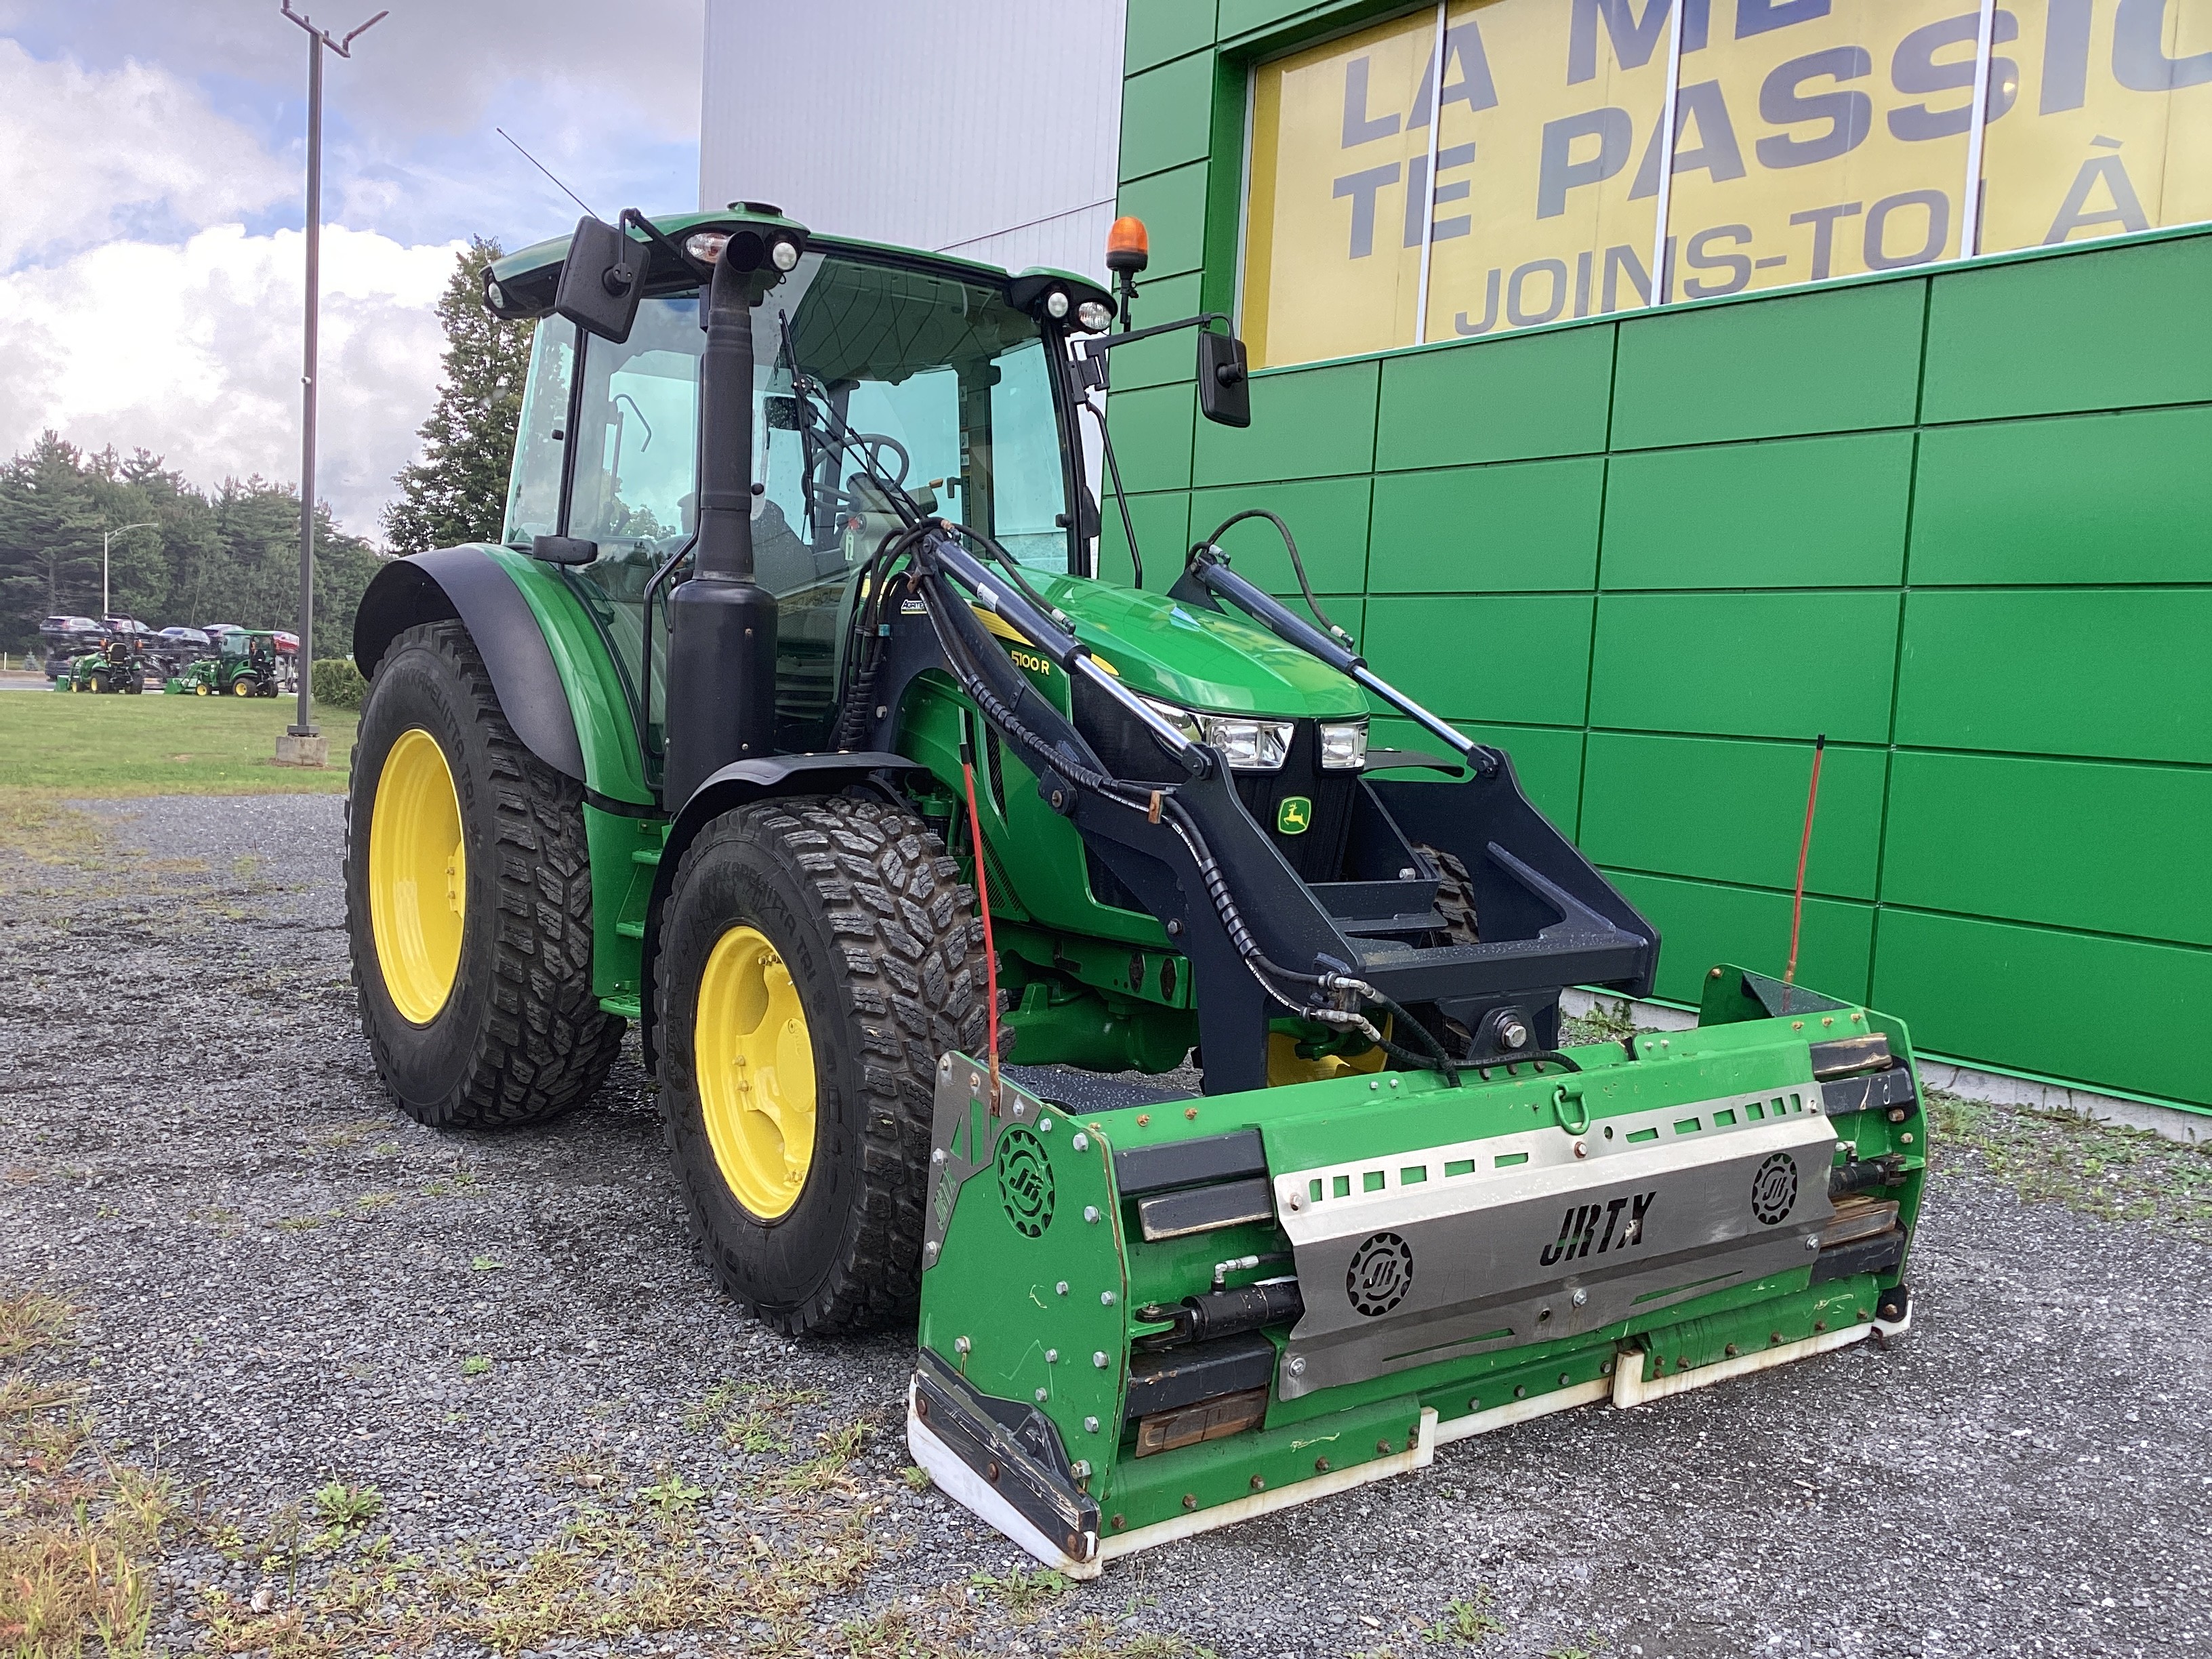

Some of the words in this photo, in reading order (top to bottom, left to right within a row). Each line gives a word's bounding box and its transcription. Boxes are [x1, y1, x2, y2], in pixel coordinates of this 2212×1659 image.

[1341, 21, 1498, 149] LA
[1332, 141, 1476, 260] TE
[2042, 135, 2150, 245] À
[903, 600, 925, 609] AGRITE
[1011, 650, 1039, 671] 5100
[1539, 1191, 1657, 1267] JRTX
